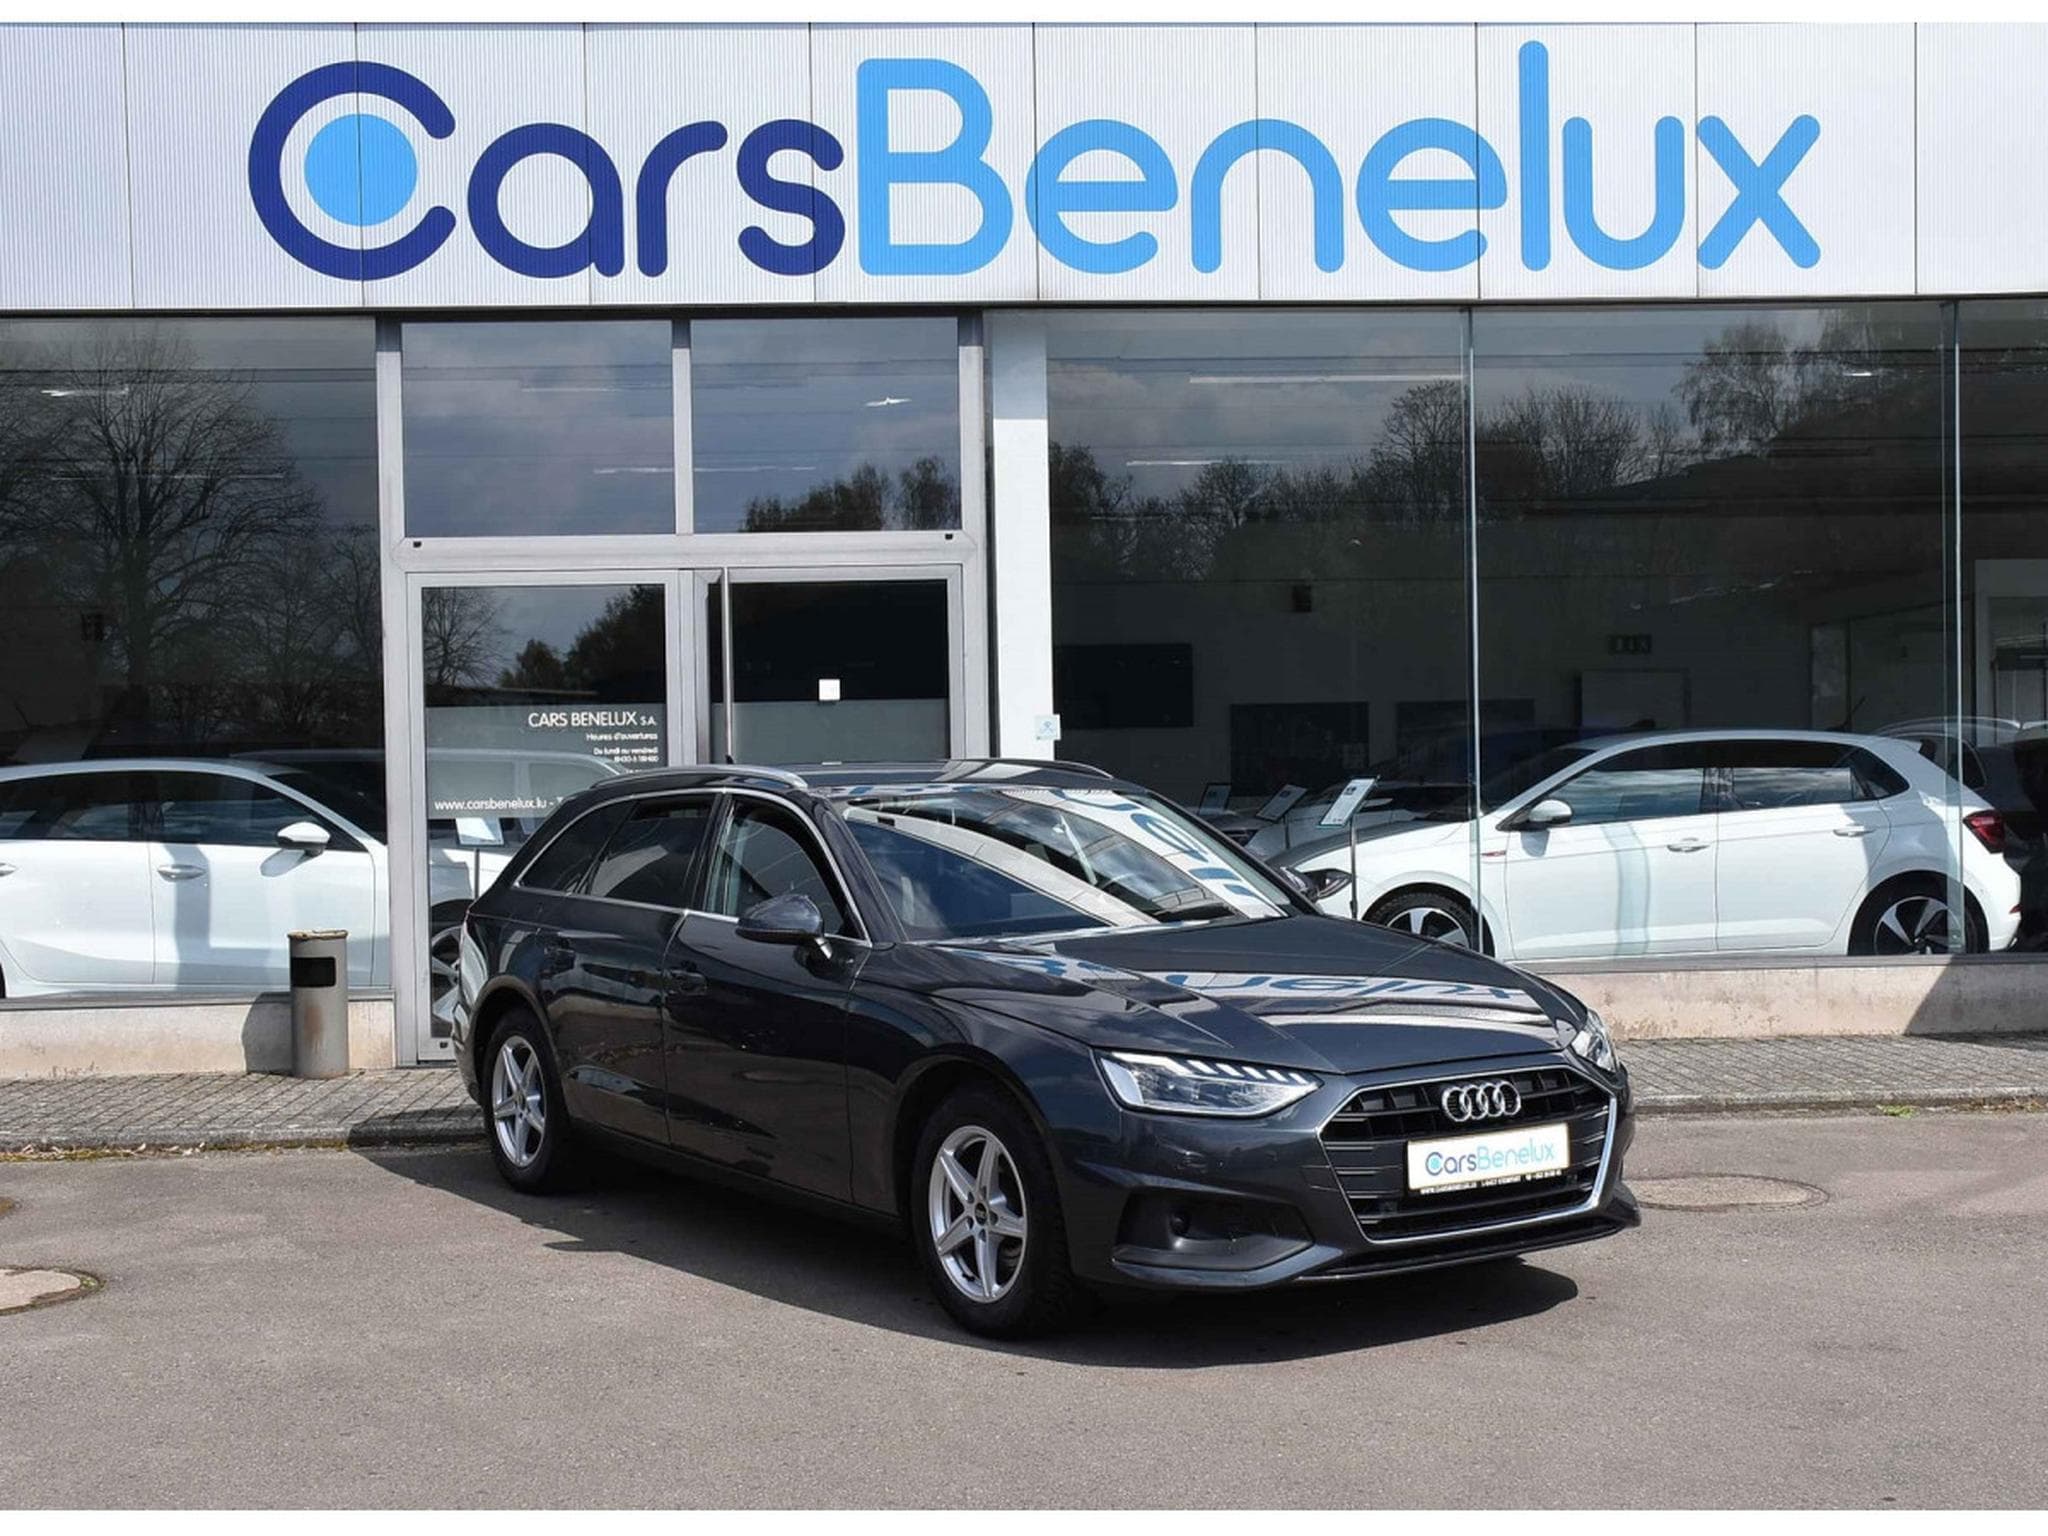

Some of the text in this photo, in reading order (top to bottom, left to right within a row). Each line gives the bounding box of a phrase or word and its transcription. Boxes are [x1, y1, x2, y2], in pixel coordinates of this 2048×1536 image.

[248, 41, 1820, 281] CarsBenelux
[528, 712, 568, 728] CARS
[571, 711, 638, 727] BENELUX
[586, 732, 612, 741] Heures
[434, 796, 547, 811] www.carsbenelux.lu
[1425, 1138, 1554, 1176] CarsBenelux
